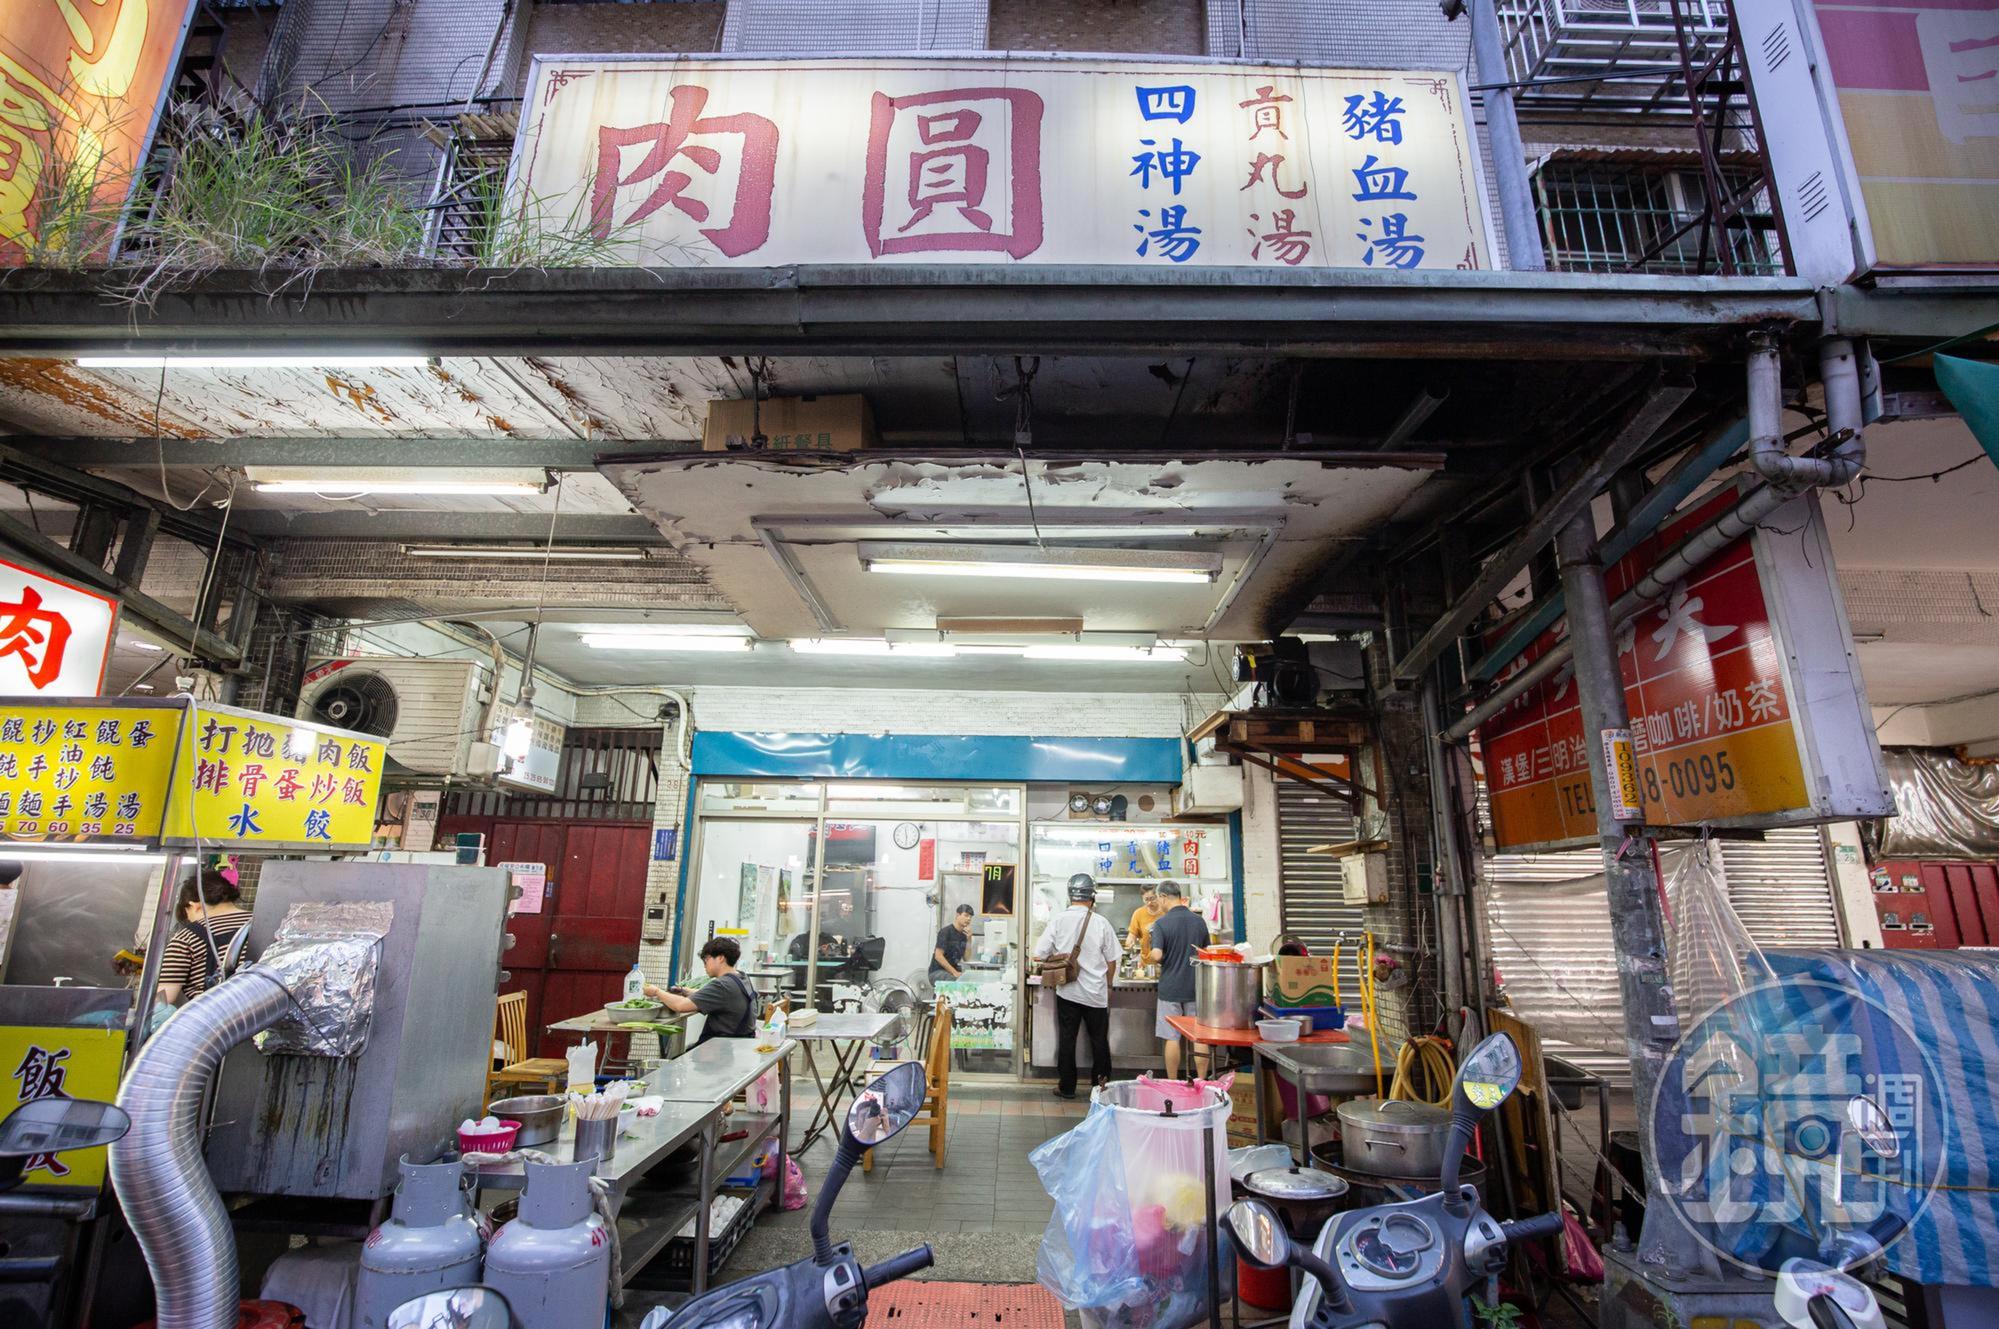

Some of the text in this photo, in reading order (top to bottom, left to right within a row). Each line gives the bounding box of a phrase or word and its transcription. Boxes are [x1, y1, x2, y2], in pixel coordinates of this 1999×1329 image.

[589, 85, 1044, 259] 肉圓
[1129, 85, 1202, 262] 四神湯
[1239, 86, 1312, 265] 貢丸湯
[1342, 91, 1425, 269] 豬血湯
[0, 586, 72, 690] 肉
[18, 821, 135, 834] 70 60 35 25
[194, 758, 367, 807] 排骨蛋炒飯
[228, 803, 332, 840] 水餃
[1640, 750, 1735, 805] 8-0095
